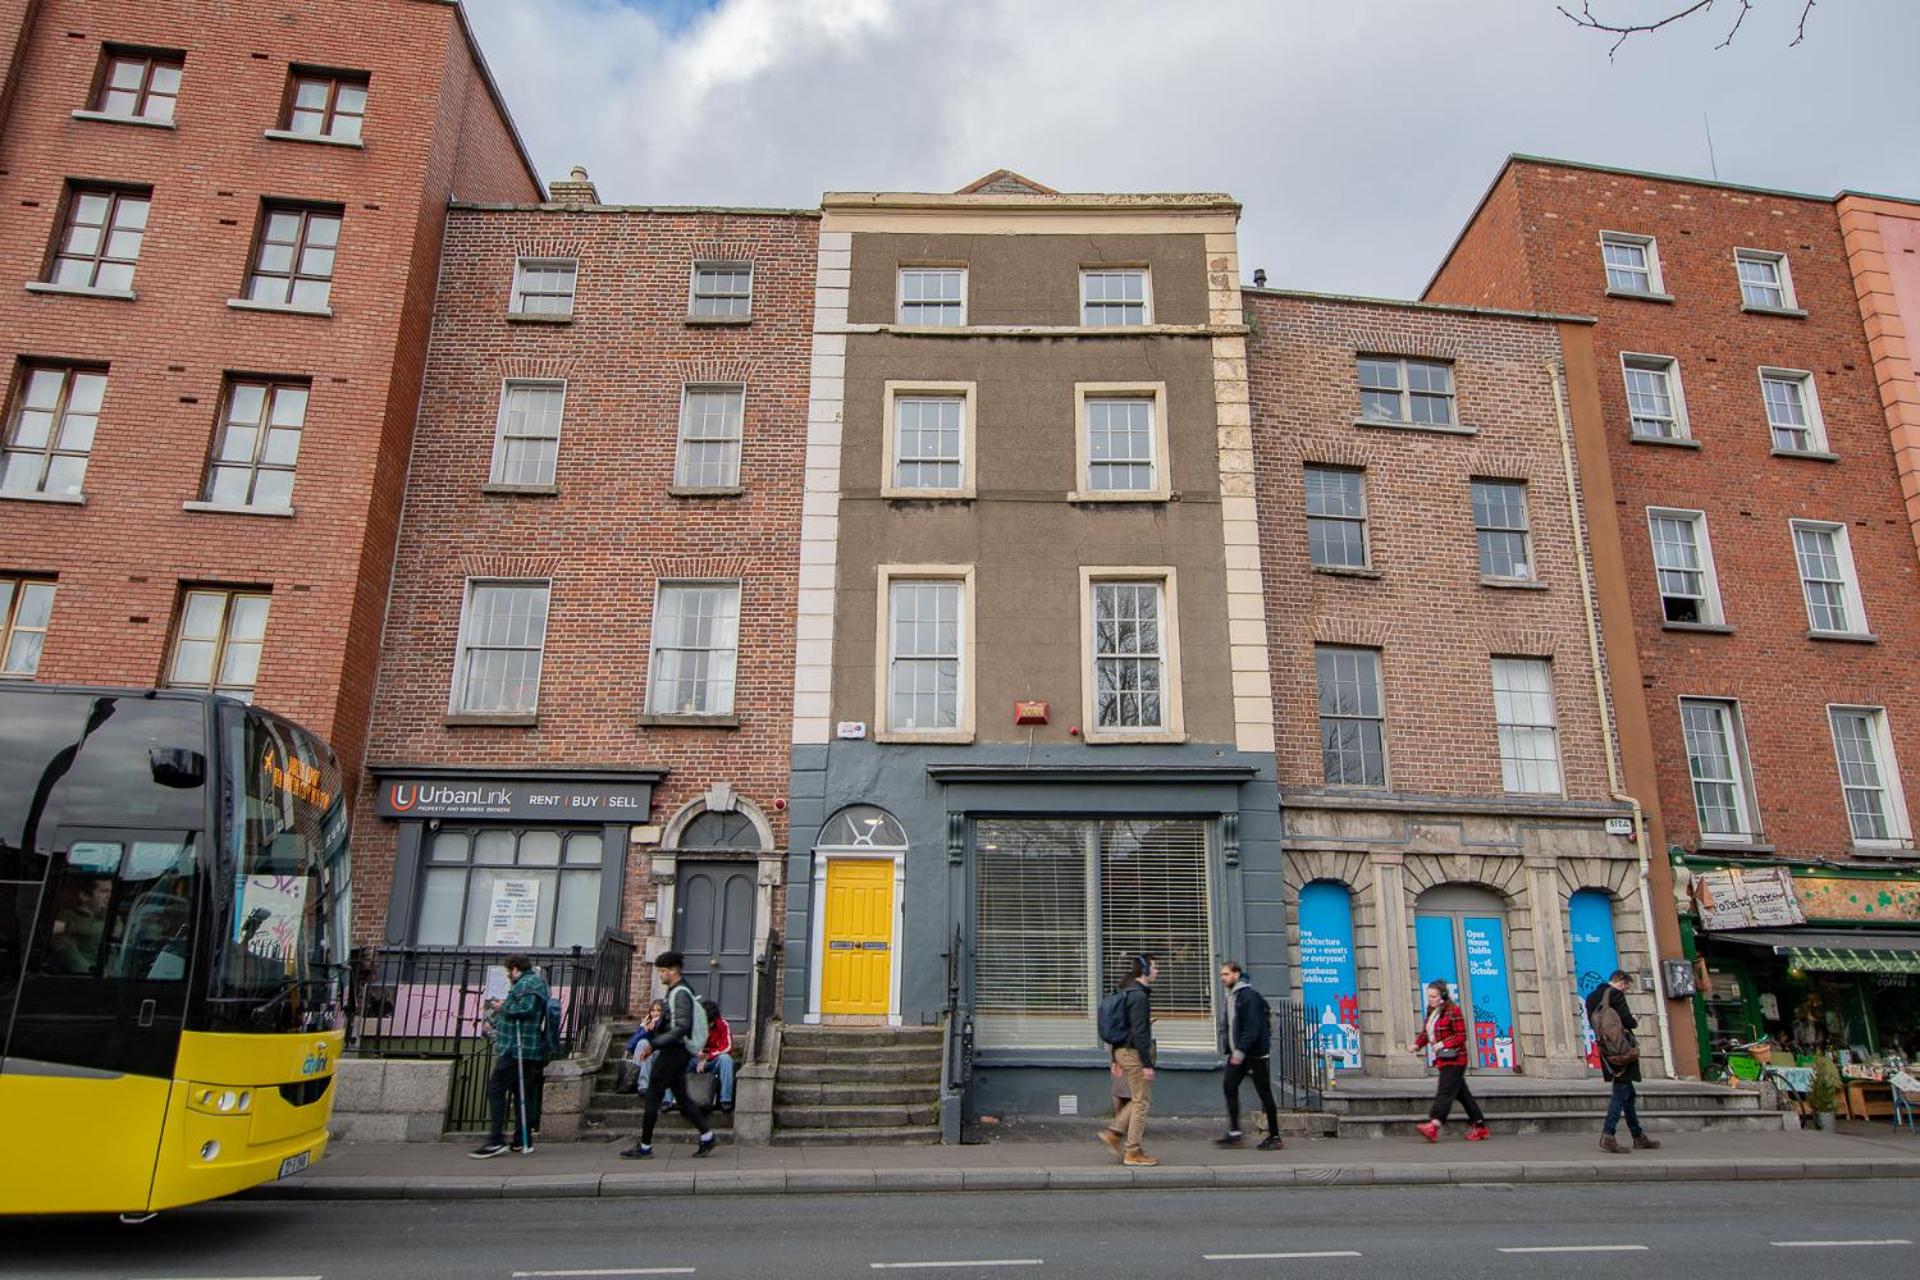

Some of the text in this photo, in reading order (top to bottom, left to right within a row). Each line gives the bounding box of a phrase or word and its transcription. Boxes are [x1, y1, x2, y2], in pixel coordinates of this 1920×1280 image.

[419, 785, 512, 804] UrbanLink
[529, 795, 639, 808] RENT BUY SELL
[1466, 929, 1486, 940] Open
[1300, 938, 1341, 946] rchitecture
[1467, 939, 1490, 947] House
[1324, 946, 1348, 954] events
[1469, 946, 1492, 955] Dublin
[1302, 967, 1337, 975] penhouse
[1470, 967, 1499, 975] October
